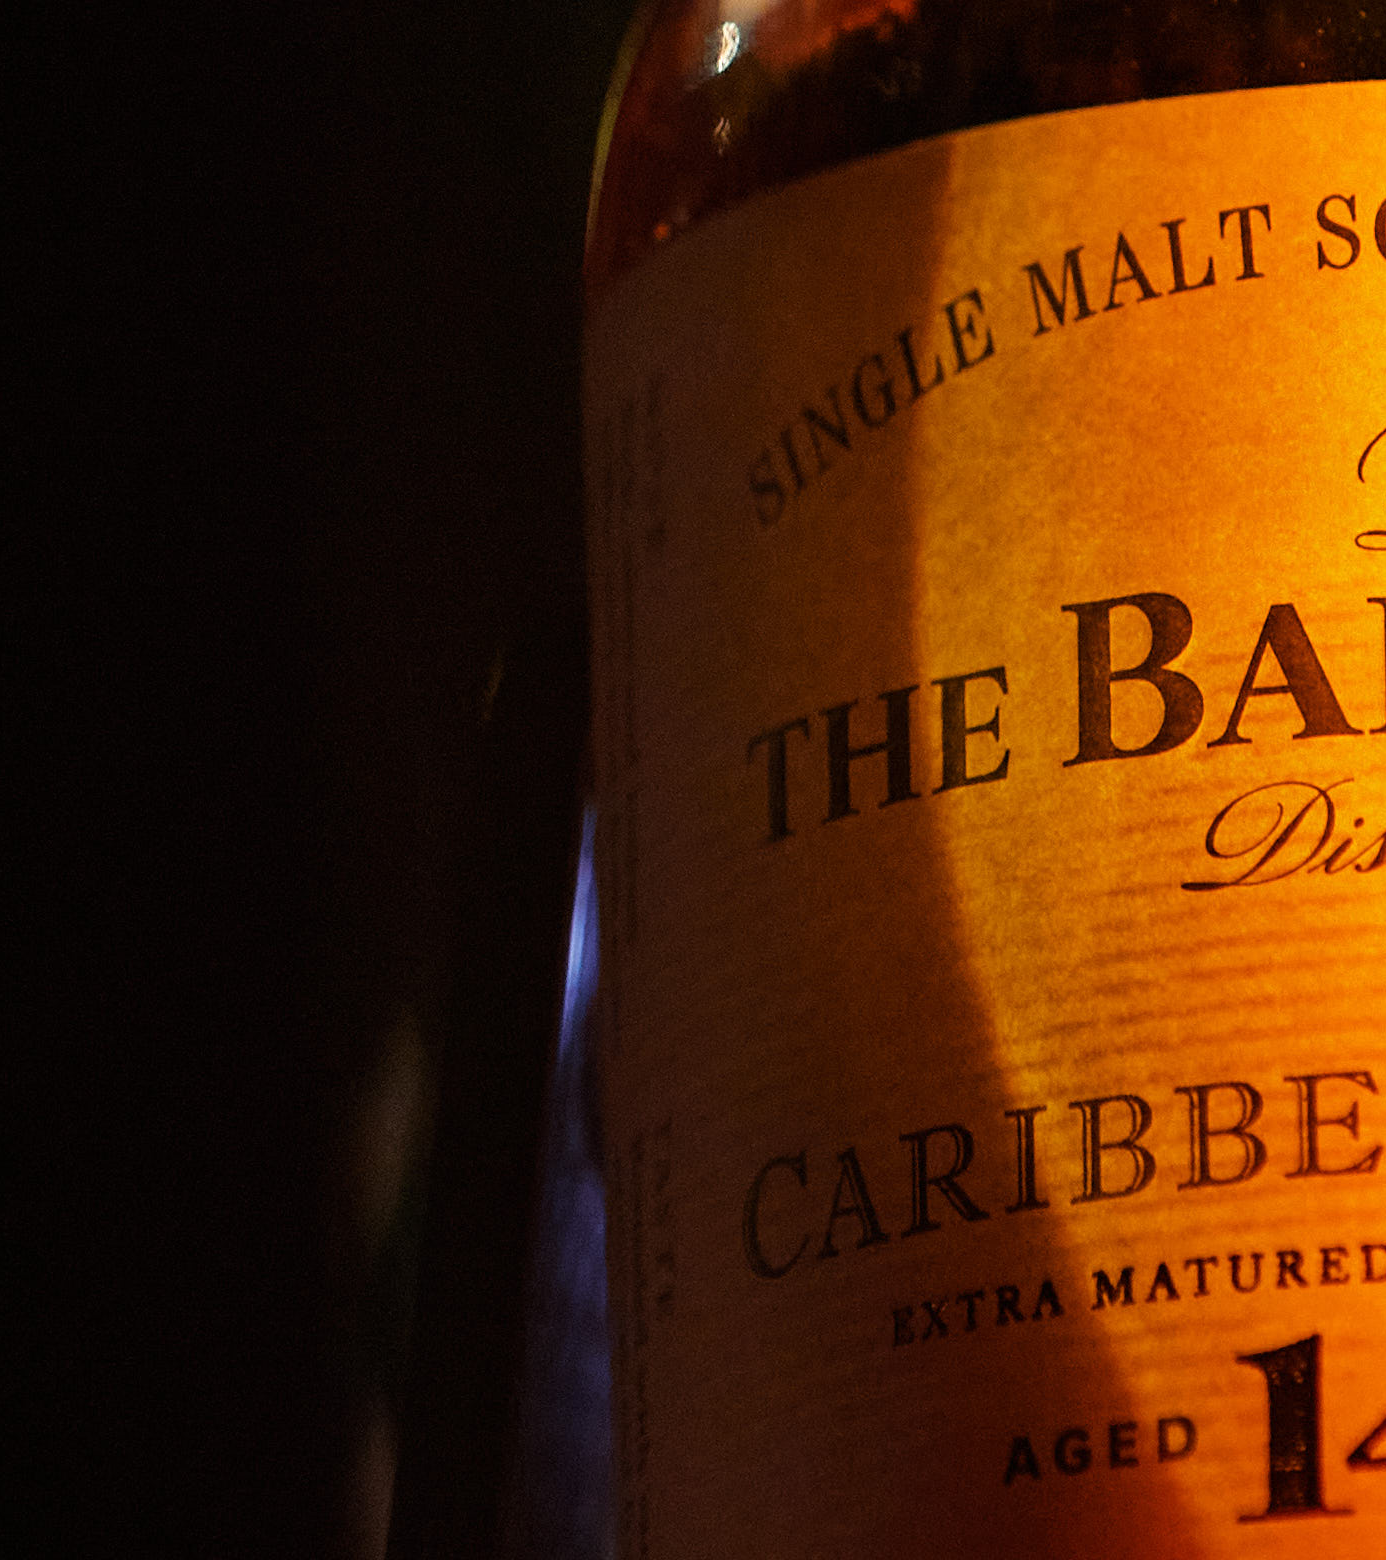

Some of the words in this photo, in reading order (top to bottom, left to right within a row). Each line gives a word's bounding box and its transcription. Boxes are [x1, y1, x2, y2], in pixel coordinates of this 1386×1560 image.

[747, 289, 996, 528] SINGLE
[1023, 202, 1272, 337] MALT
[746, 665, 1012, 844] THE
[891, 1276, 1065, 1352] EXTRA
[1002, 1413, 1200, 1488] AGED
